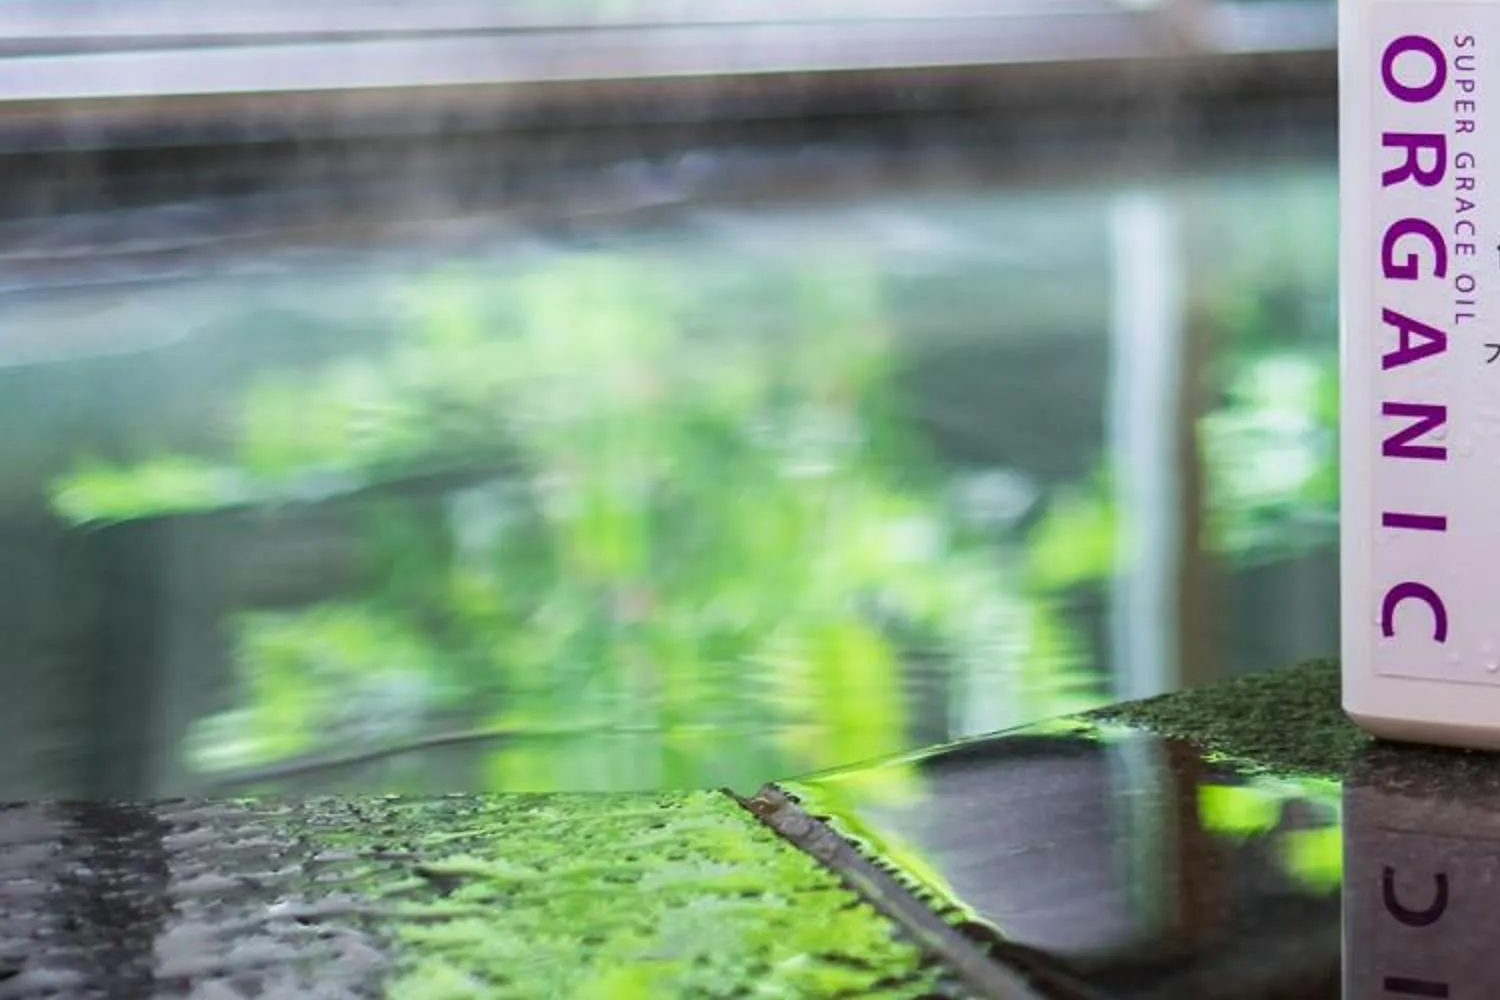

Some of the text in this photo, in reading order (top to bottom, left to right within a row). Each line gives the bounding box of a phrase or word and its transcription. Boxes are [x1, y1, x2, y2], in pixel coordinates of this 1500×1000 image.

[1380, 34, 1448, 644] ORGANIC
[1453, 34, 1476, 326] SUPER GRACE OIL
